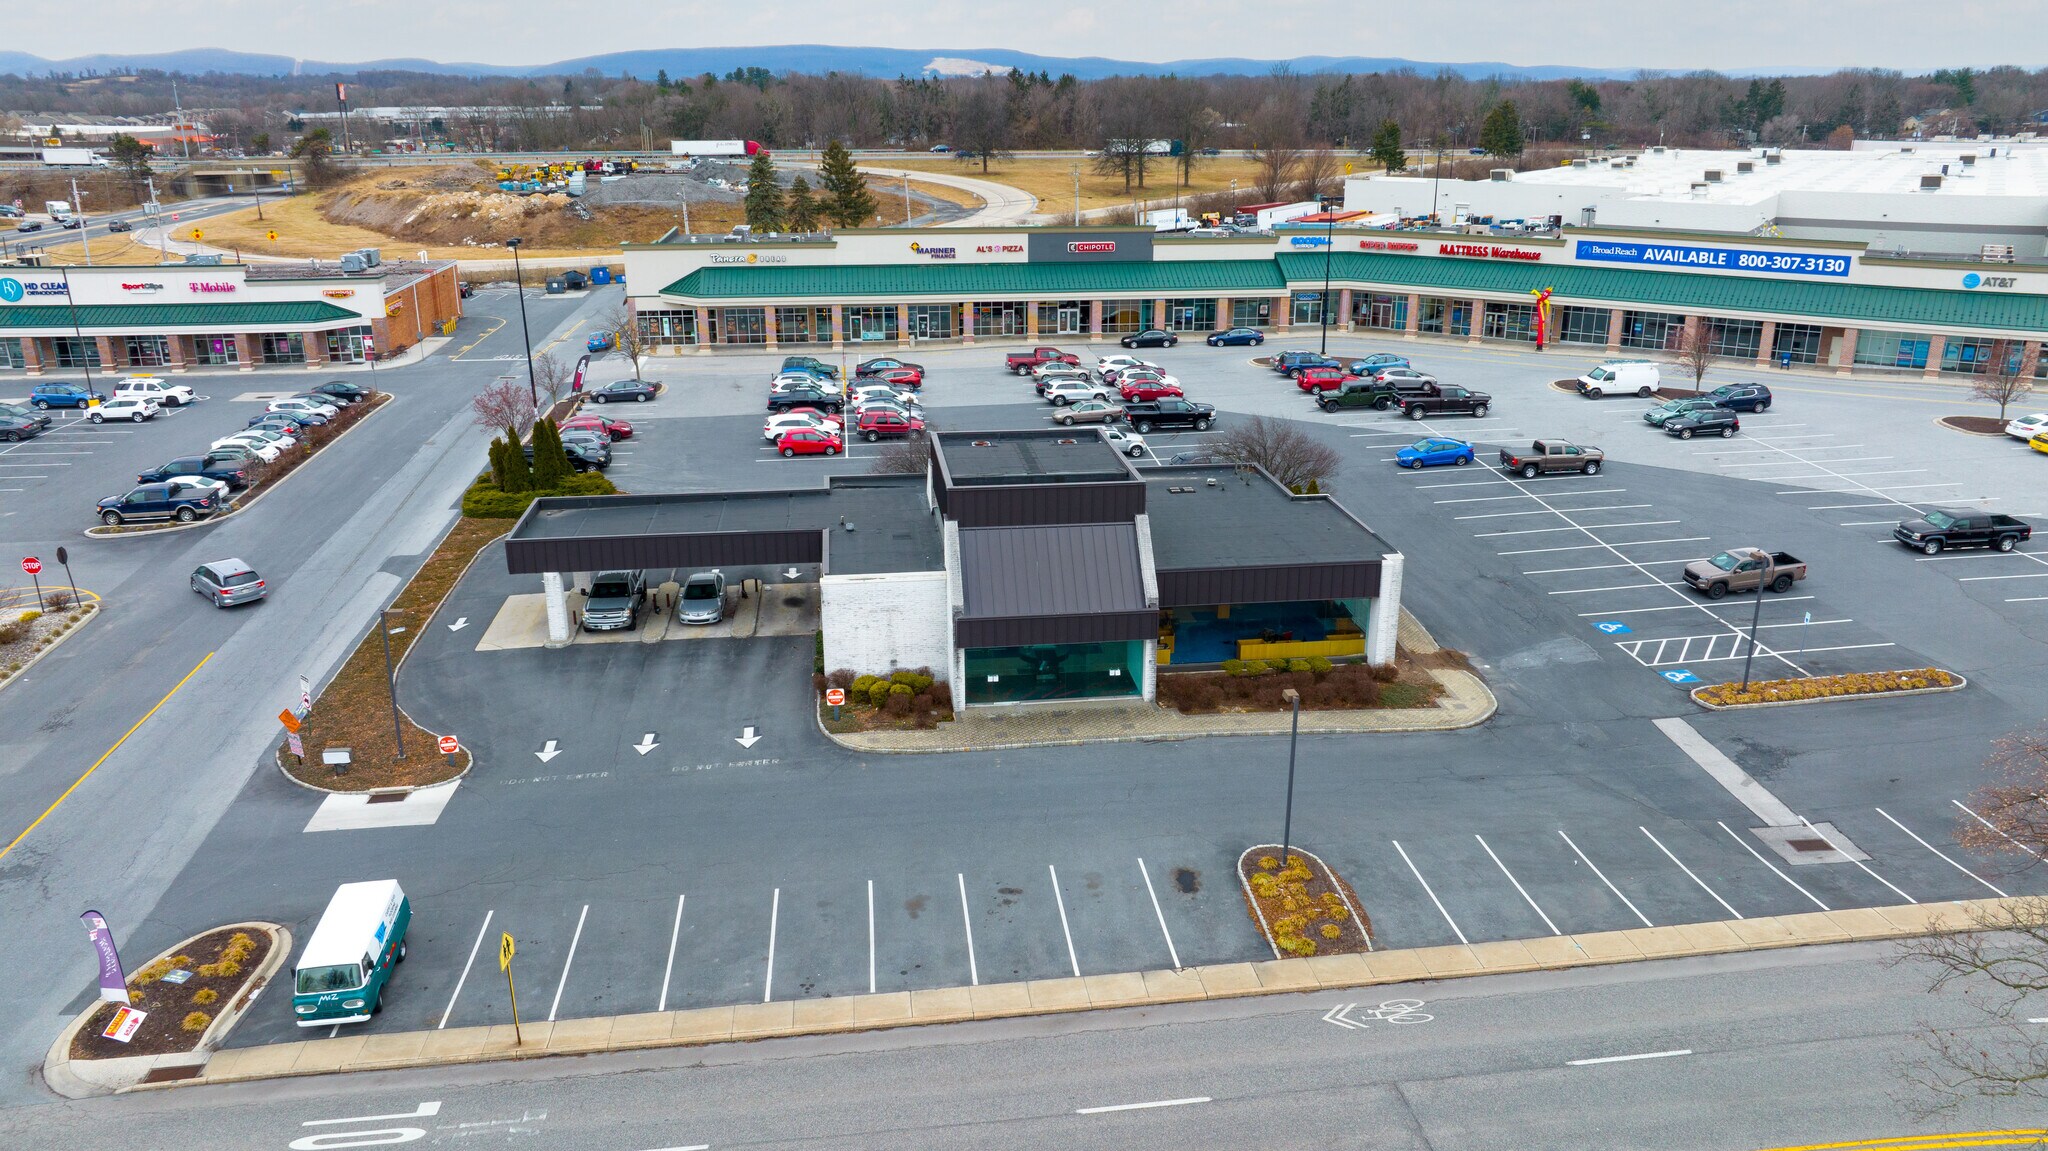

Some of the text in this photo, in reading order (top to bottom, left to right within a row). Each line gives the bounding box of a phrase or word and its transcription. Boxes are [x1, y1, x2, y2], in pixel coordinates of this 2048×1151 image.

[976, 245, 1024, 253] AL'S PIZZA
[1439, 244, 1542, 261] MATTRESS Warehouse
[1591, 245, 1638, 256] Broad Reach
[1643, 248, 1846, 273] AVAILABLE 800-307-3130
[24, 282, 38, 290] HD
[1981, 276, 2018, 288] AT&T
